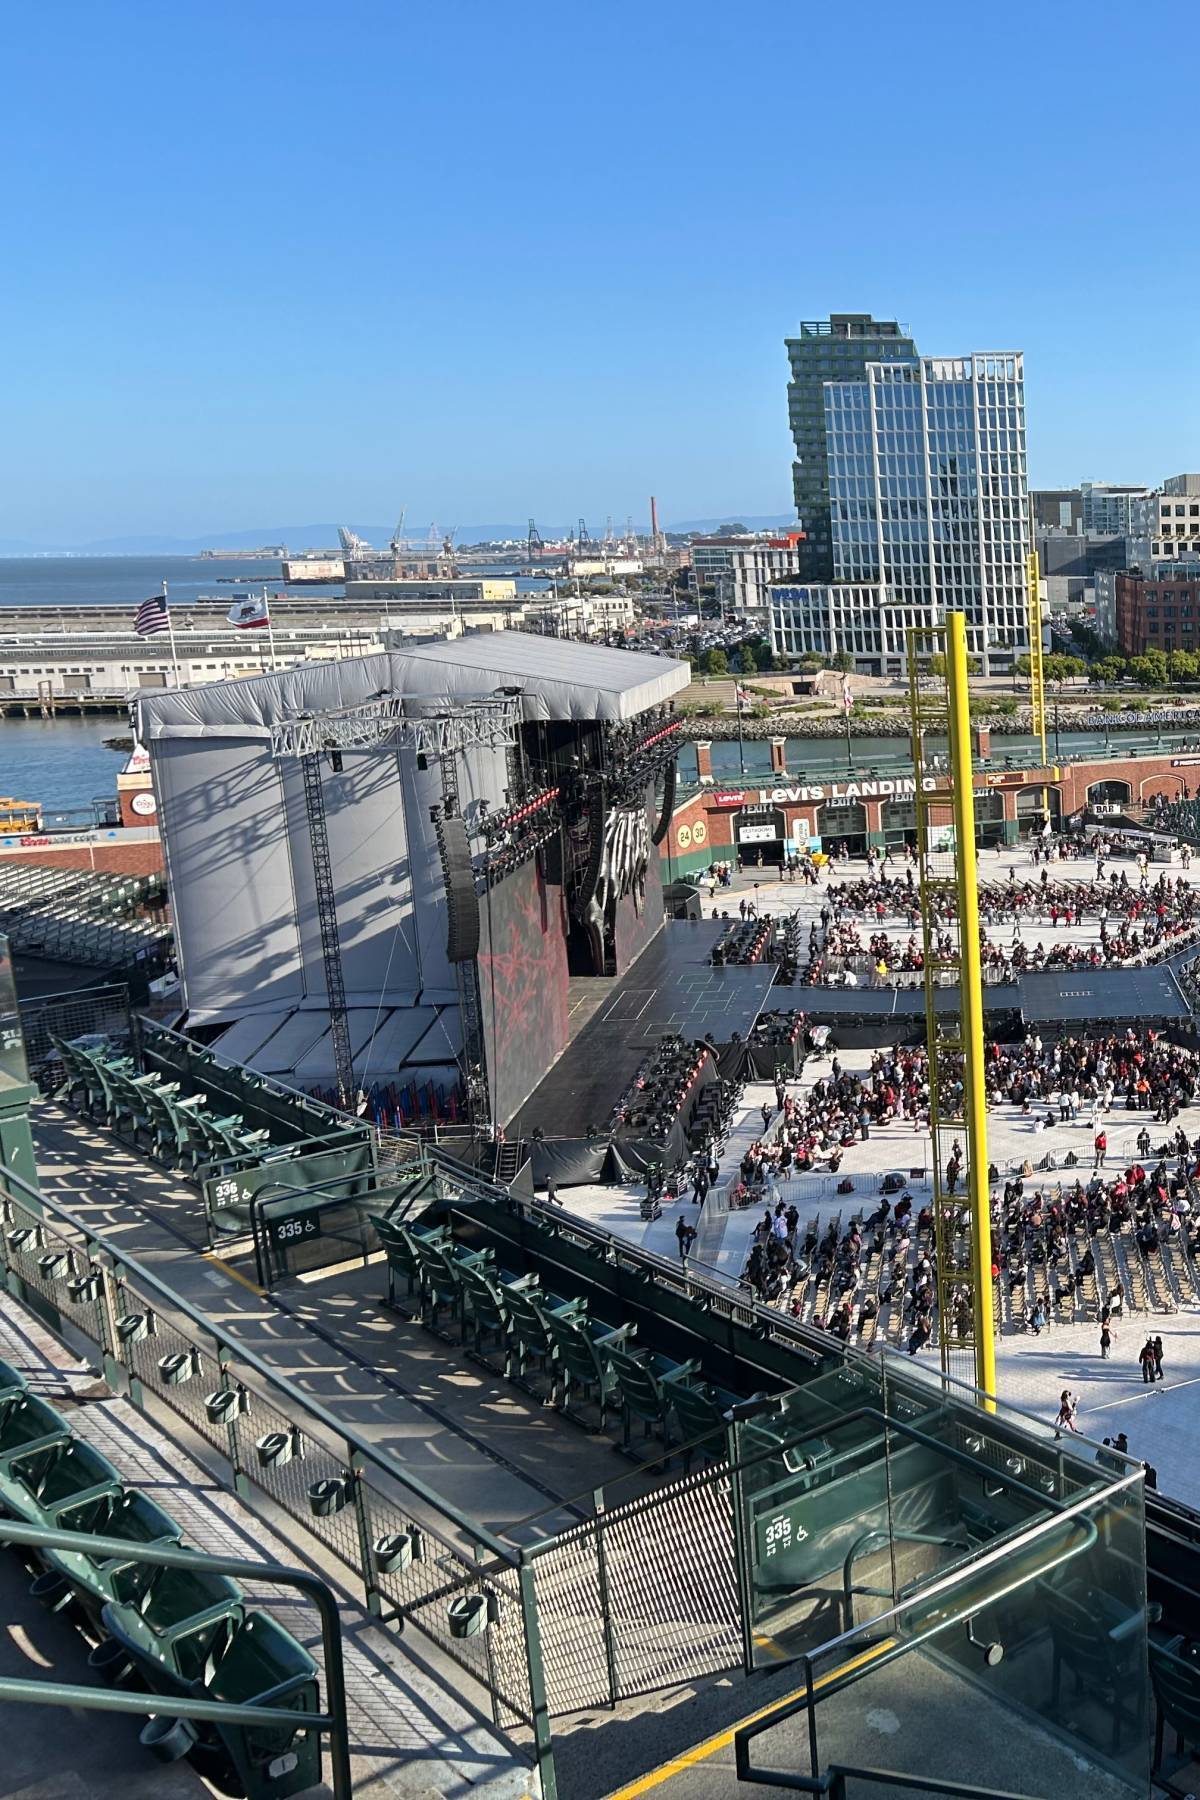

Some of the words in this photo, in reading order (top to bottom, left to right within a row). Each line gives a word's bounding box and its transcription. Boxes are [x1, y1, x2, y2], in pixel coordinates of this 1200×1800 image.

[1088, 714, 1126, 725] BANK
[1126, 713, 1141, 723] OF
[1144, 709, 1200, 722] AMERICA
[832, 777, 937, 798] LANDING
[831, 797, 850, 807] EXIT
[895, 792, 914, 802] EXIT
[747, 804, 768, 814] EXIT
[1096, 805, 1114, 814] BAR
[680, 830, 690, 842] 24
[695, 827, 704, 838] 30
[216, 1182, 238, 1198] 336
[278, 1221, 302, 1239] 335
[766, 1517, 791, 1544] 335
